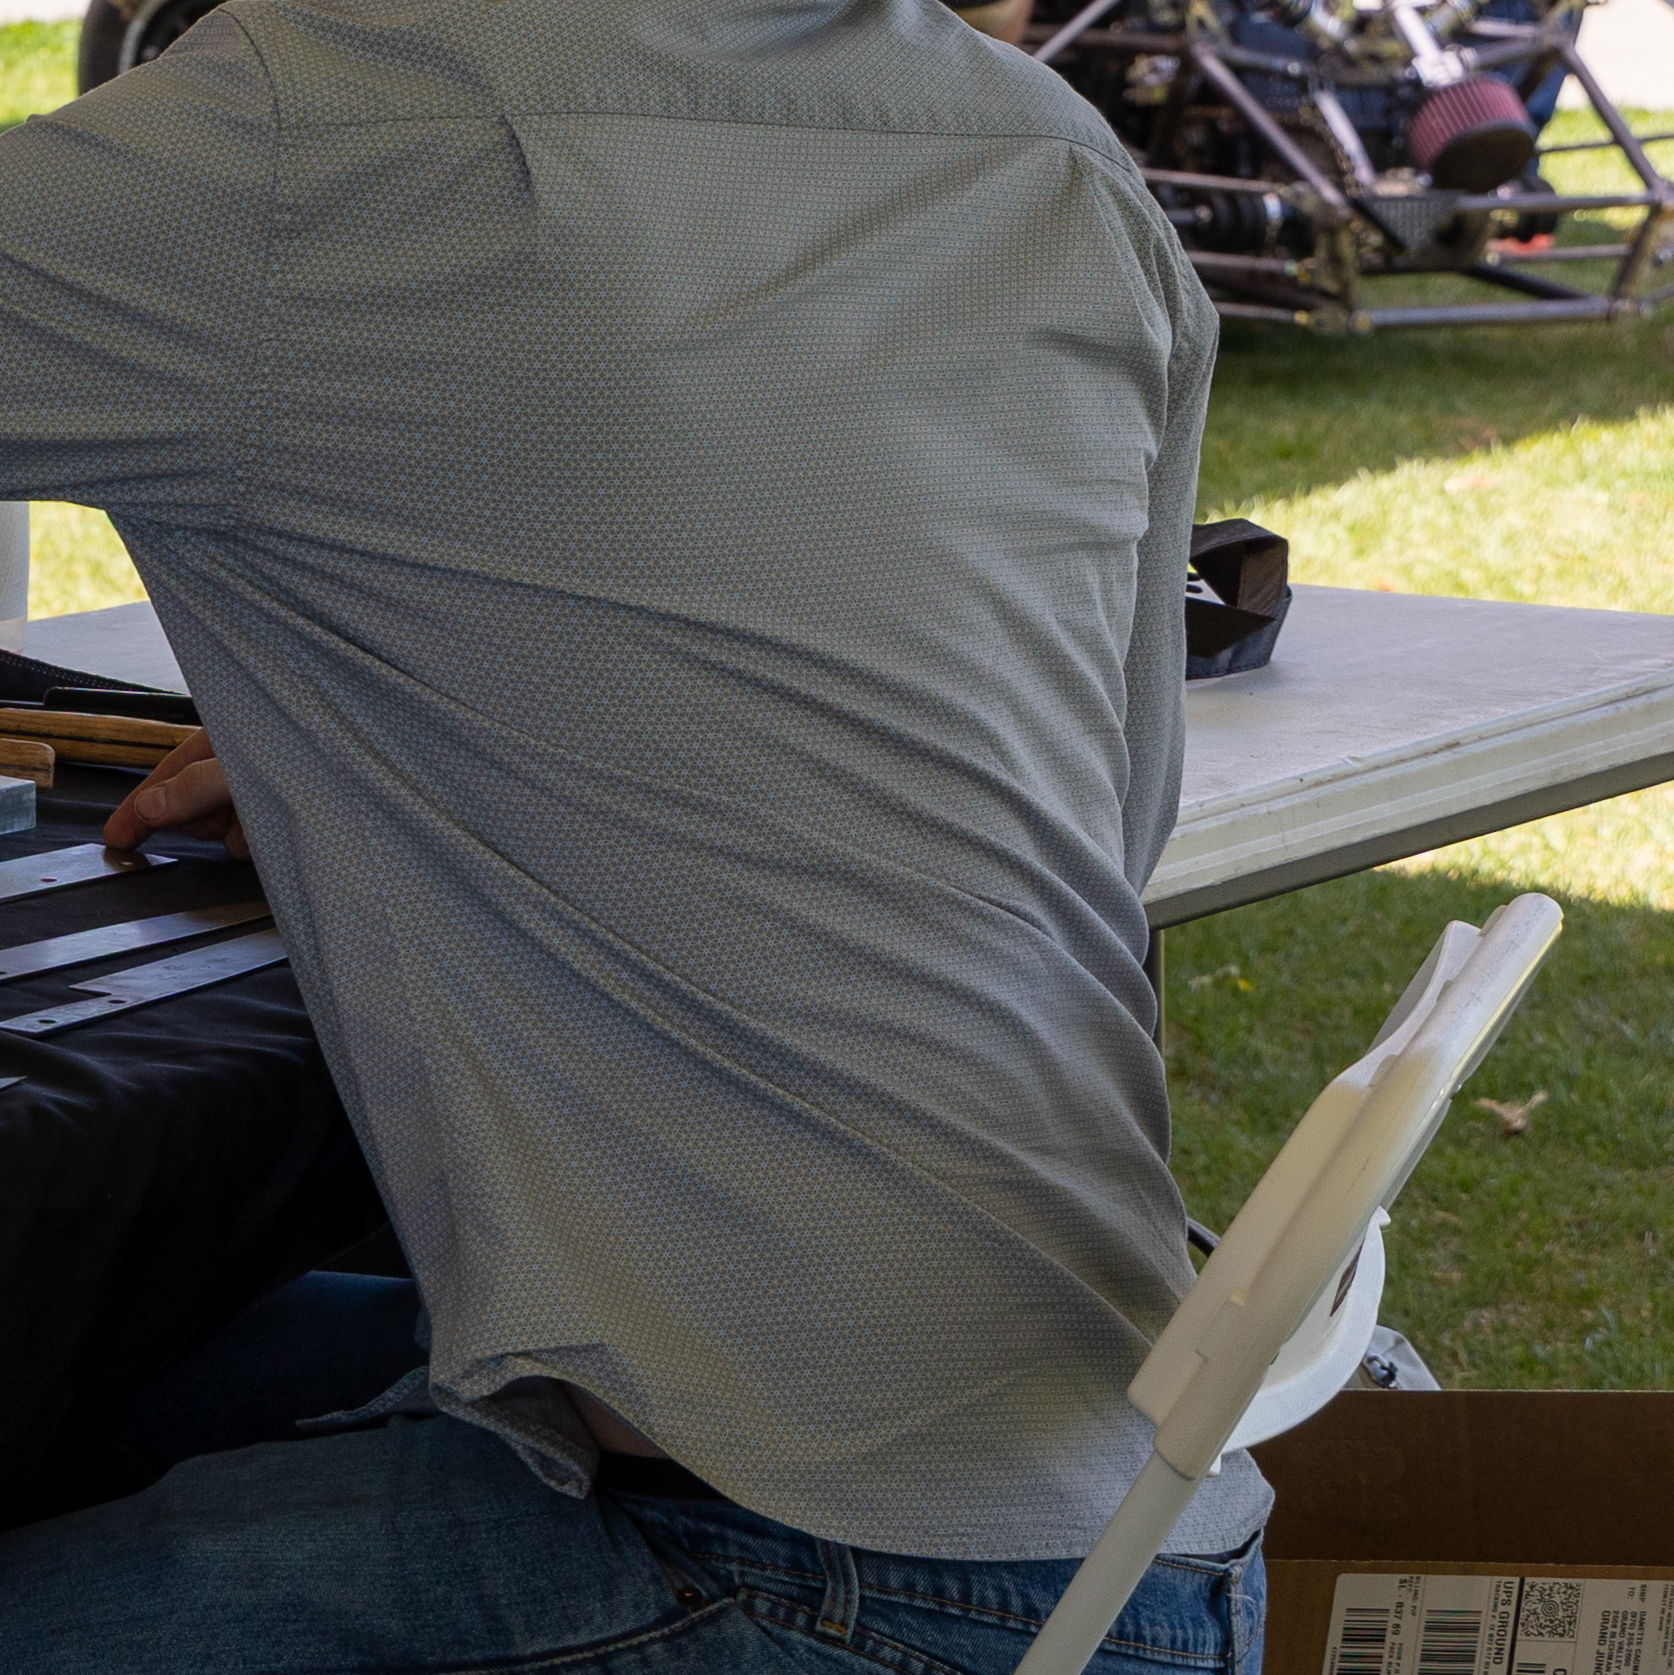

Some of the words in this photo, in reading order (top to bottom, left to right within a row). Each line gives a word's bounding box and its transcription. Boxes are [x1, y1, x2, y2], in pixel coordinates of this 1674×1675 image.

[1500, 1580, 1515, 1606] UPS
[1492, 1610, 1511, 1666] GROUND
[1597, 1610, 1612, 1646] GRAND
